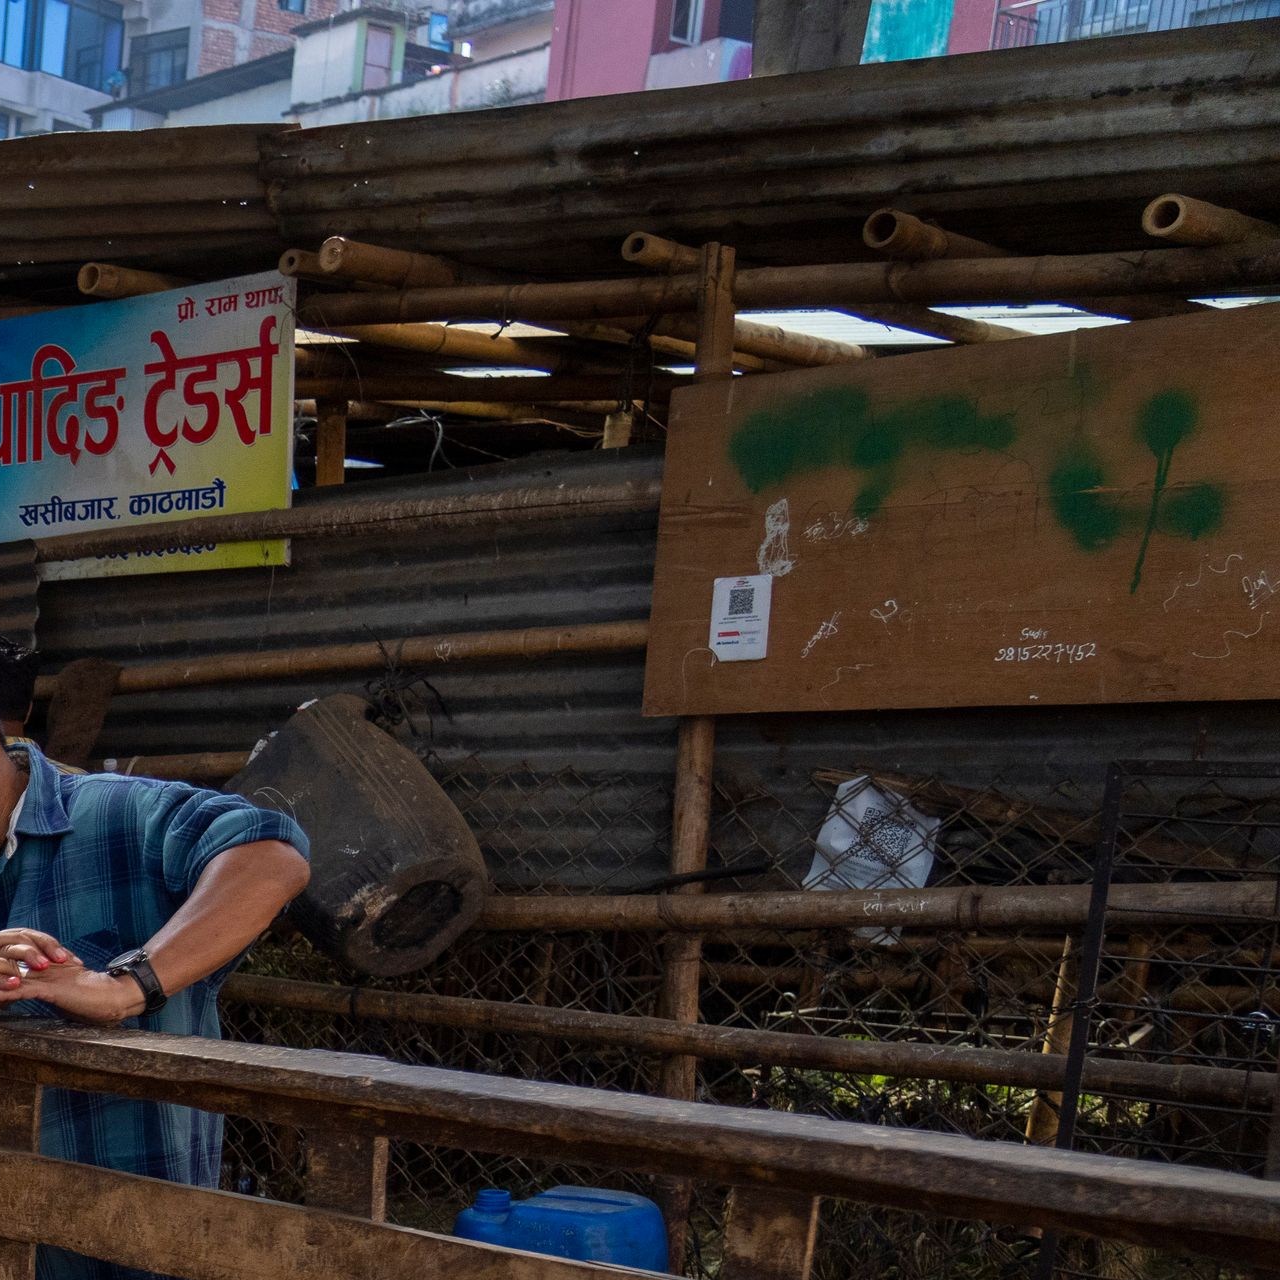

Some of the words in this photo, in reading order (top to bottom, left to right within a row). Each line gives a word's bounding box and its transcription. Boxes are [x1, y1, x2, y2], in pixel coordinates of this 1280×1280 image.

[177, 297, 199, 323] प्रो.
[205, 294, 240, 316] राम
[144, 315, 279, 476] ट्रेडर्स
